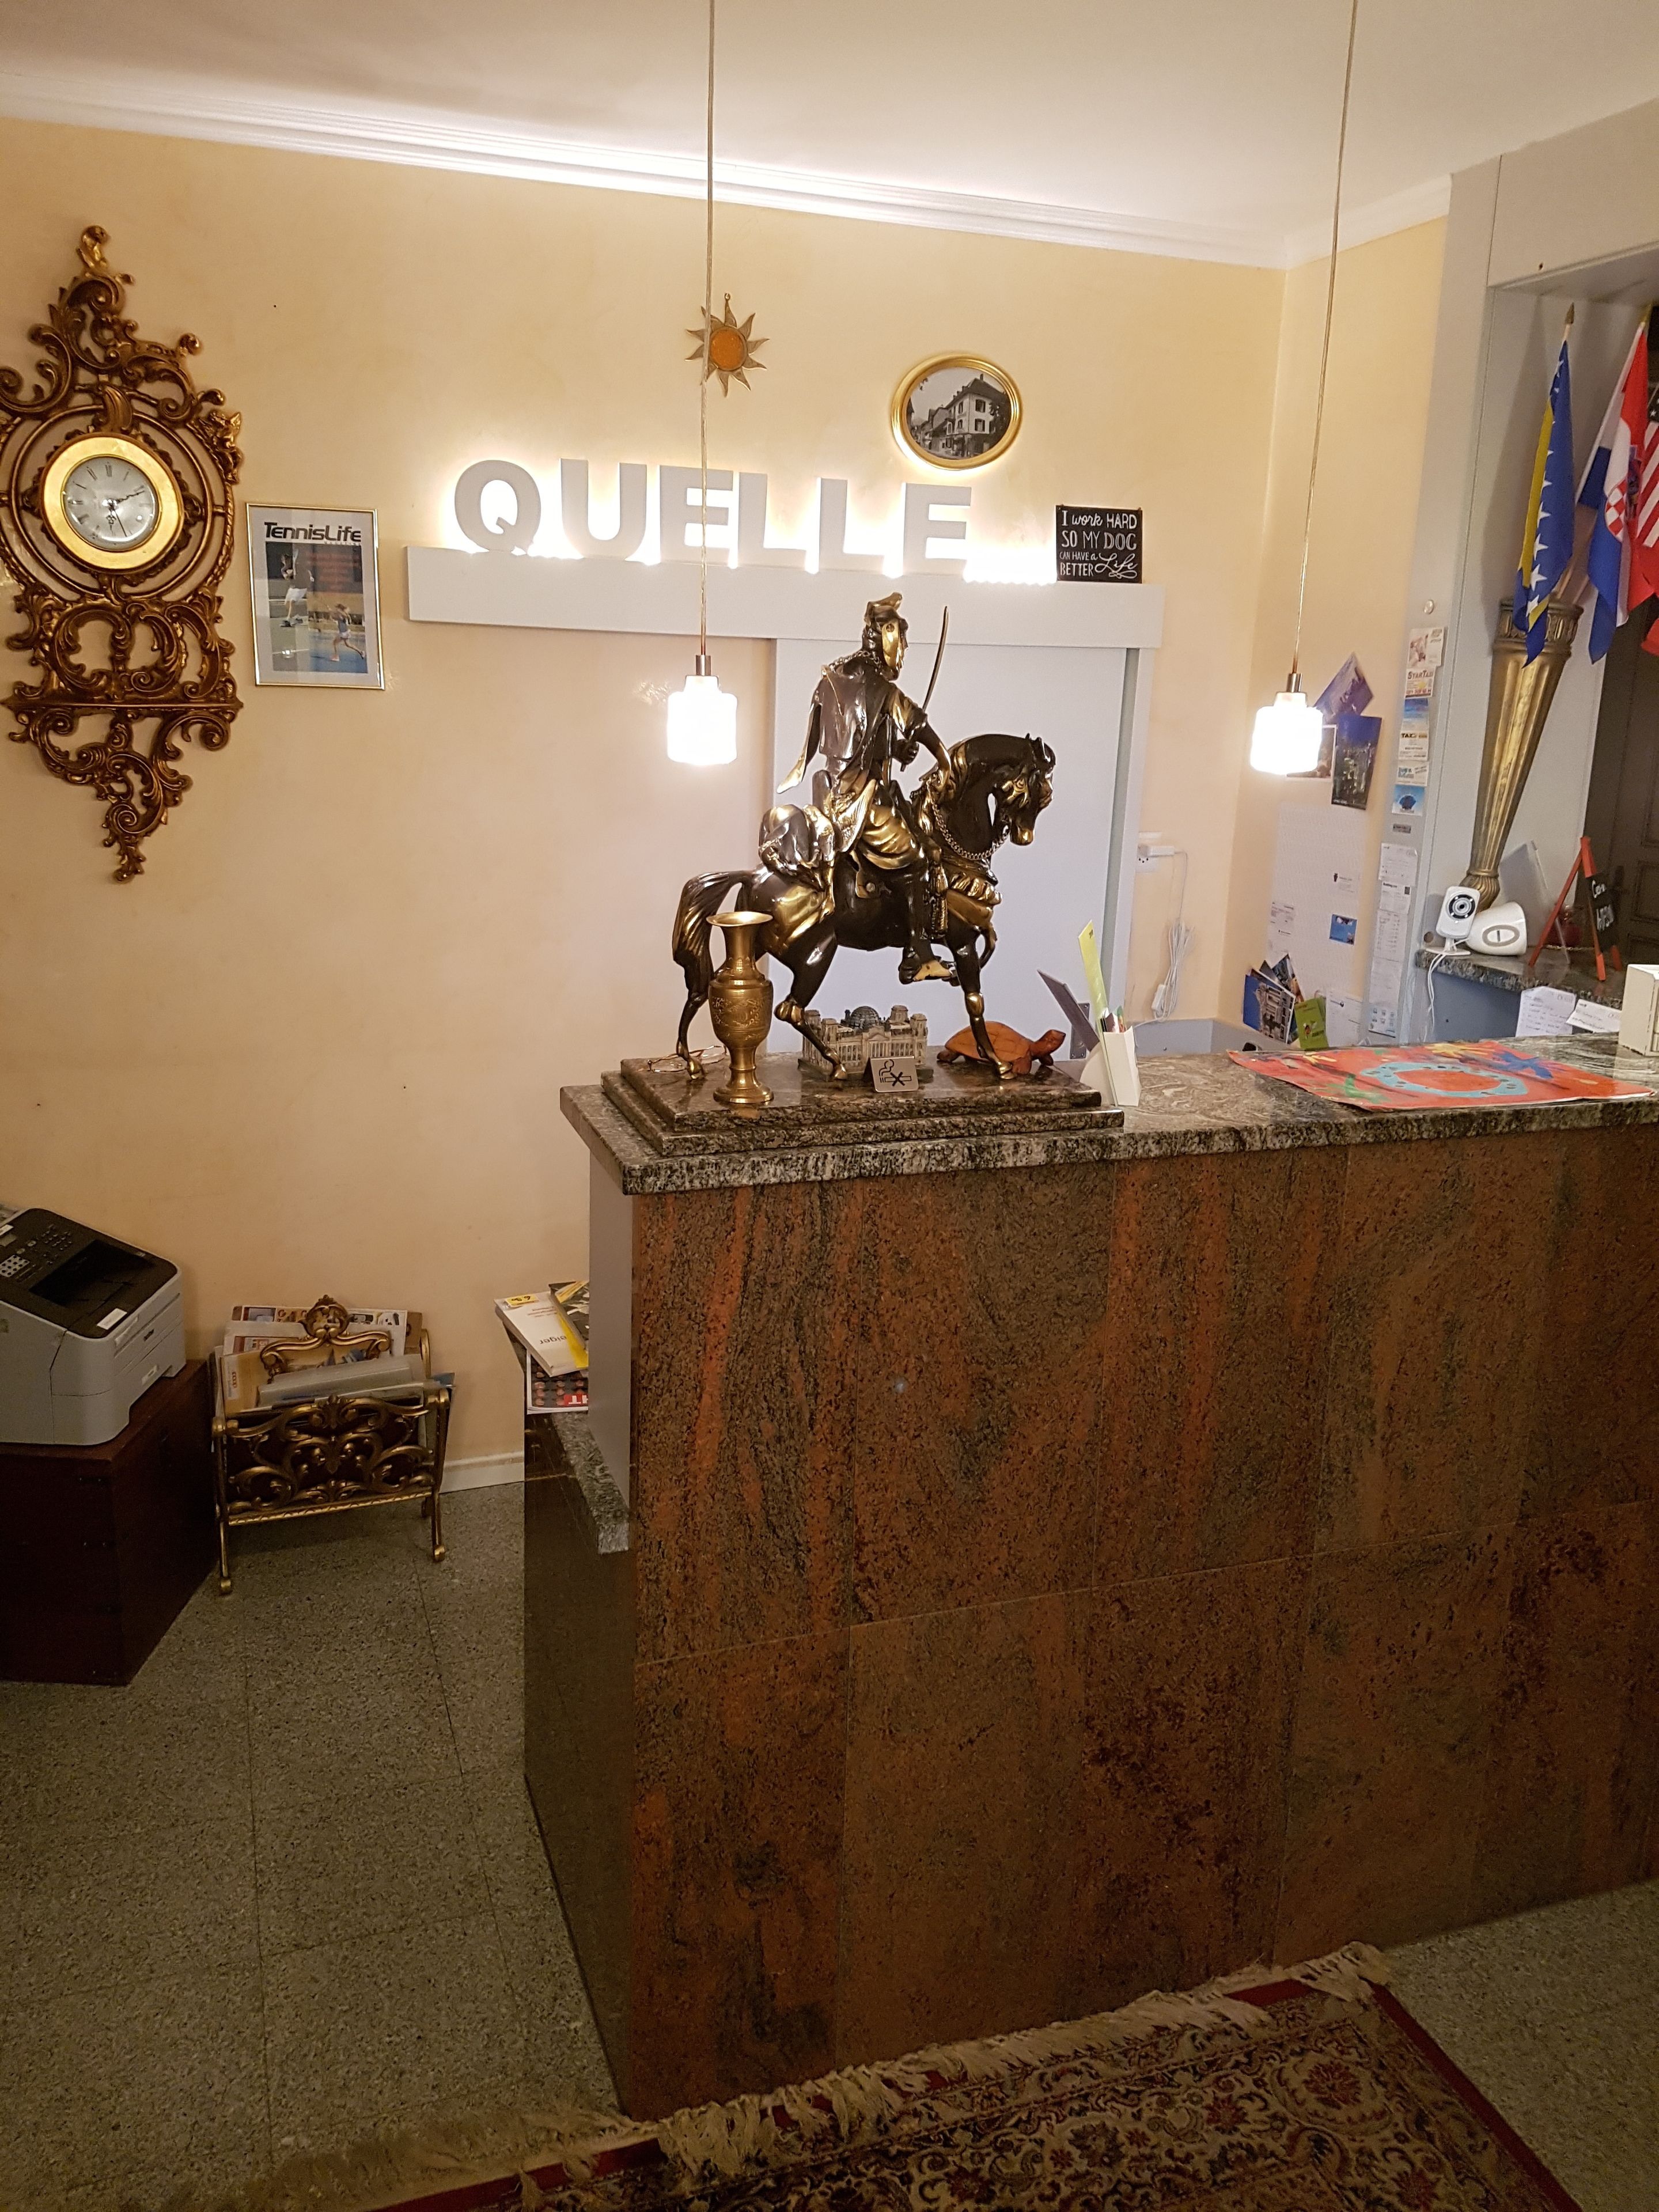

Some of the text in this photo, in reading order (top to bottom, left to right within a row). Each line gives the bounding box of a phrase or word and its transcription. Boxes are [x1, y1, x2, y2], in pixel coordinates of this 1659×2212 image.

[454, 459, 971, 575] QUELLE
[1061, 510, 1137, 529] I work HARD
[264, 521, 362, 542] TennisLife
[1061, 530, 1137, 551] SO MY DOG
[1059, 551, 1099, 561] CAN HAVE a
[1060, 552, 1138, 579] BETTER Life
